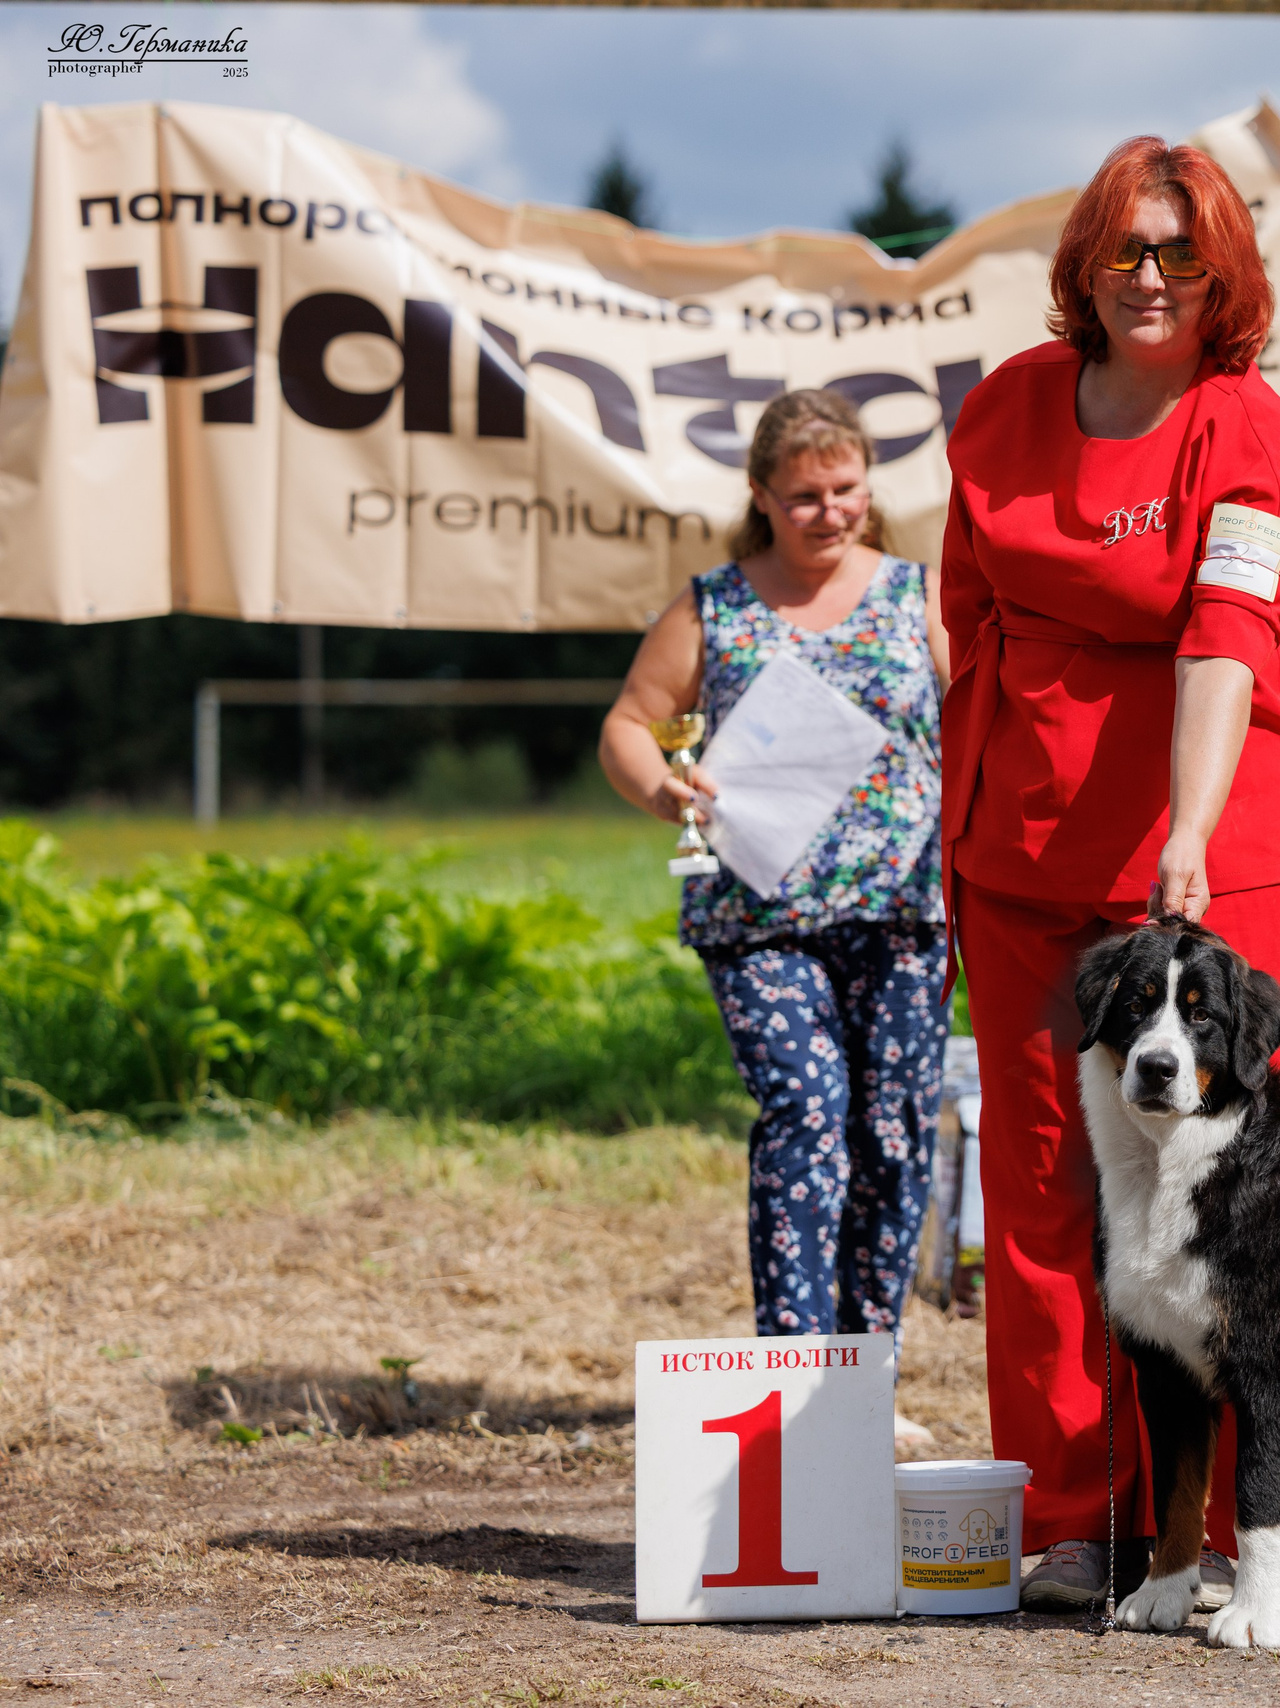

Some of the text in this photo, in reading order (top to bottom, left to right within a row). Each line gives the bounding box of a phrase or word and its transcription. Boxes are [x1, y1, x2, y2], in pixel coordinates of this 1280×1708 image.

[743, 291, 973, 338] корма
[346, 488, 712, 542] premium
[1220, 541, 1254, 579] 2
[660, 1347, 860, 1373] ИСТОК ВОЛГИ
[702, 1390, 819, 1588] 1
[904, 1574, 970, 1584] ПИЩЕВАРЕНИЕМ
[909, 1568, 985, 1577] ЧУВСТВИТЕЛЬНЫМ
